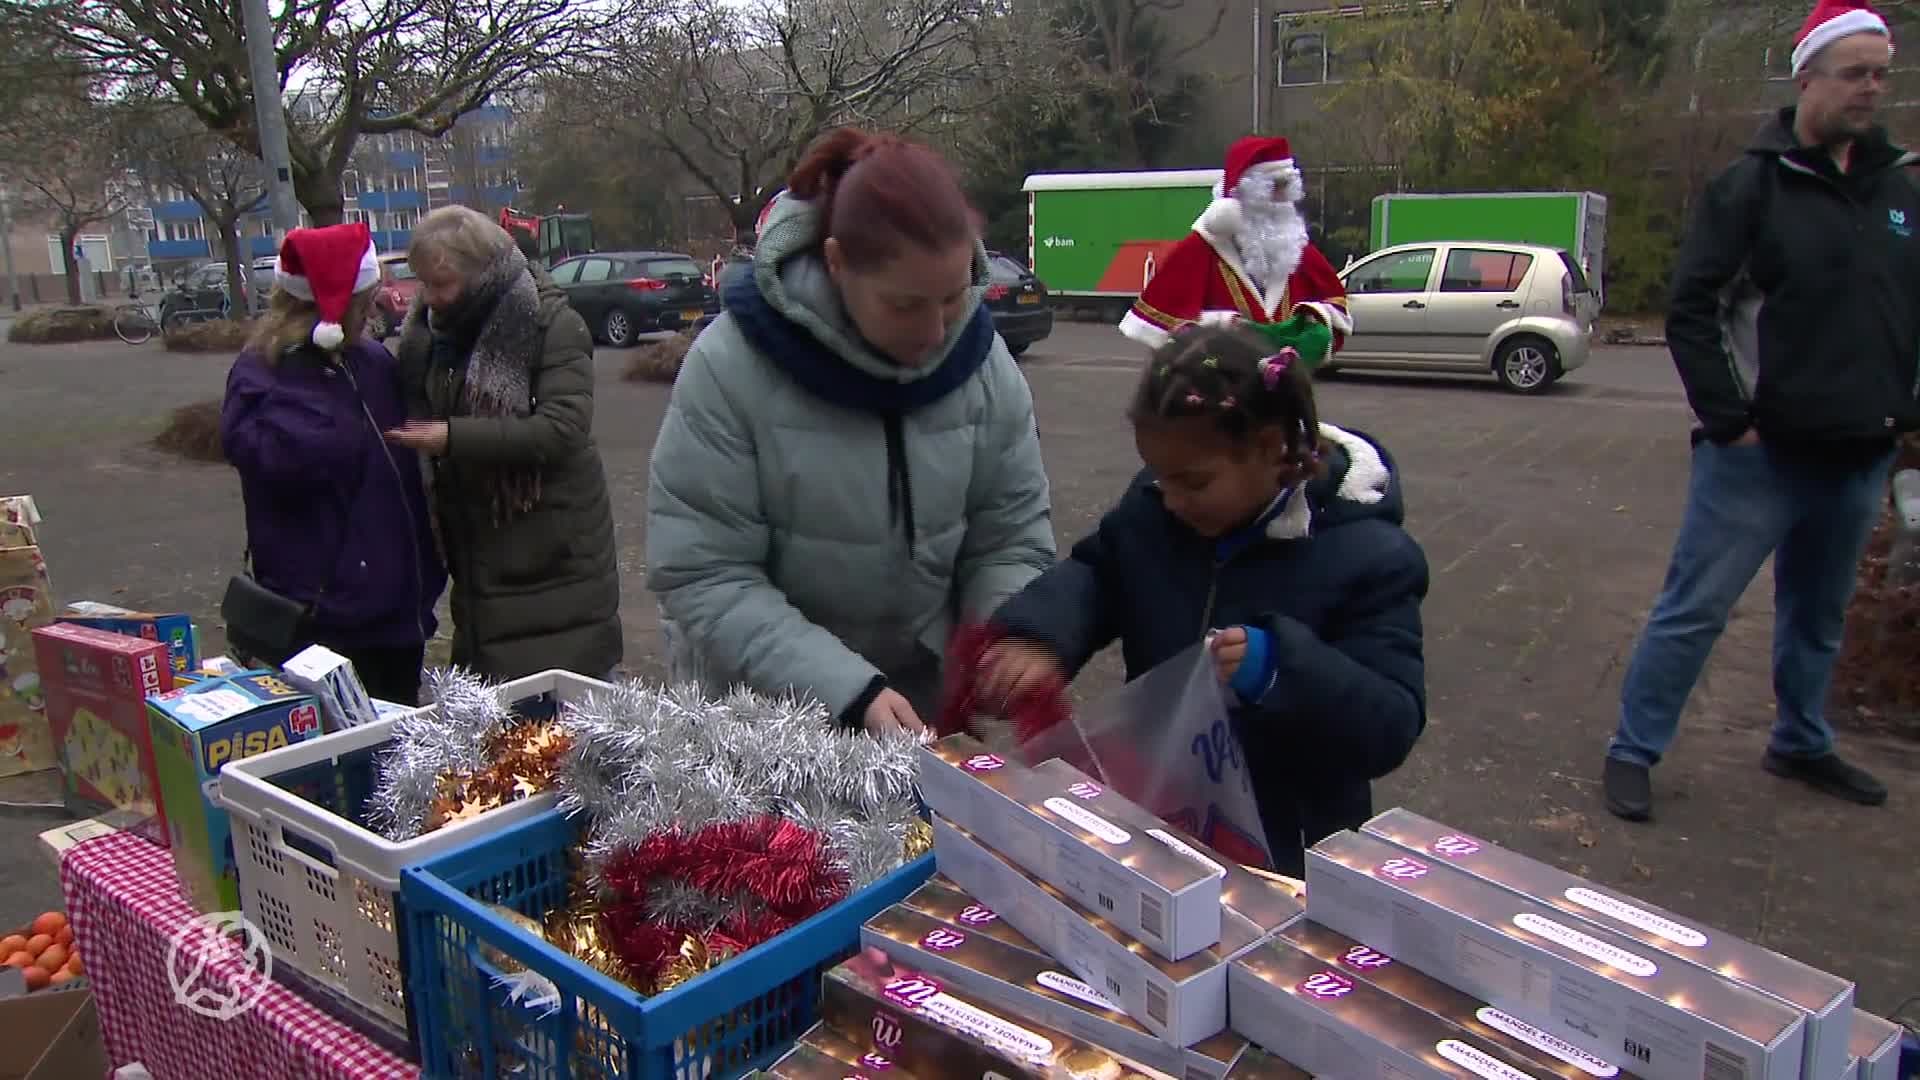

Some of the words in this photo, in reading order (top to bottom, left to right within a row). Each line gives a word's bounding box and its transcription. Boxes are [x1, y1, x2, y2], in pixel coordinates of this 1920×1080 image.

[1055, 236, 1074, 247] bam
[1486, 1010, 1536, 1036] AMANDEL
[993, 1026, 1042, 1052] AMANDEL
[1446, 1042, 1498, 1072] AMANDEL
